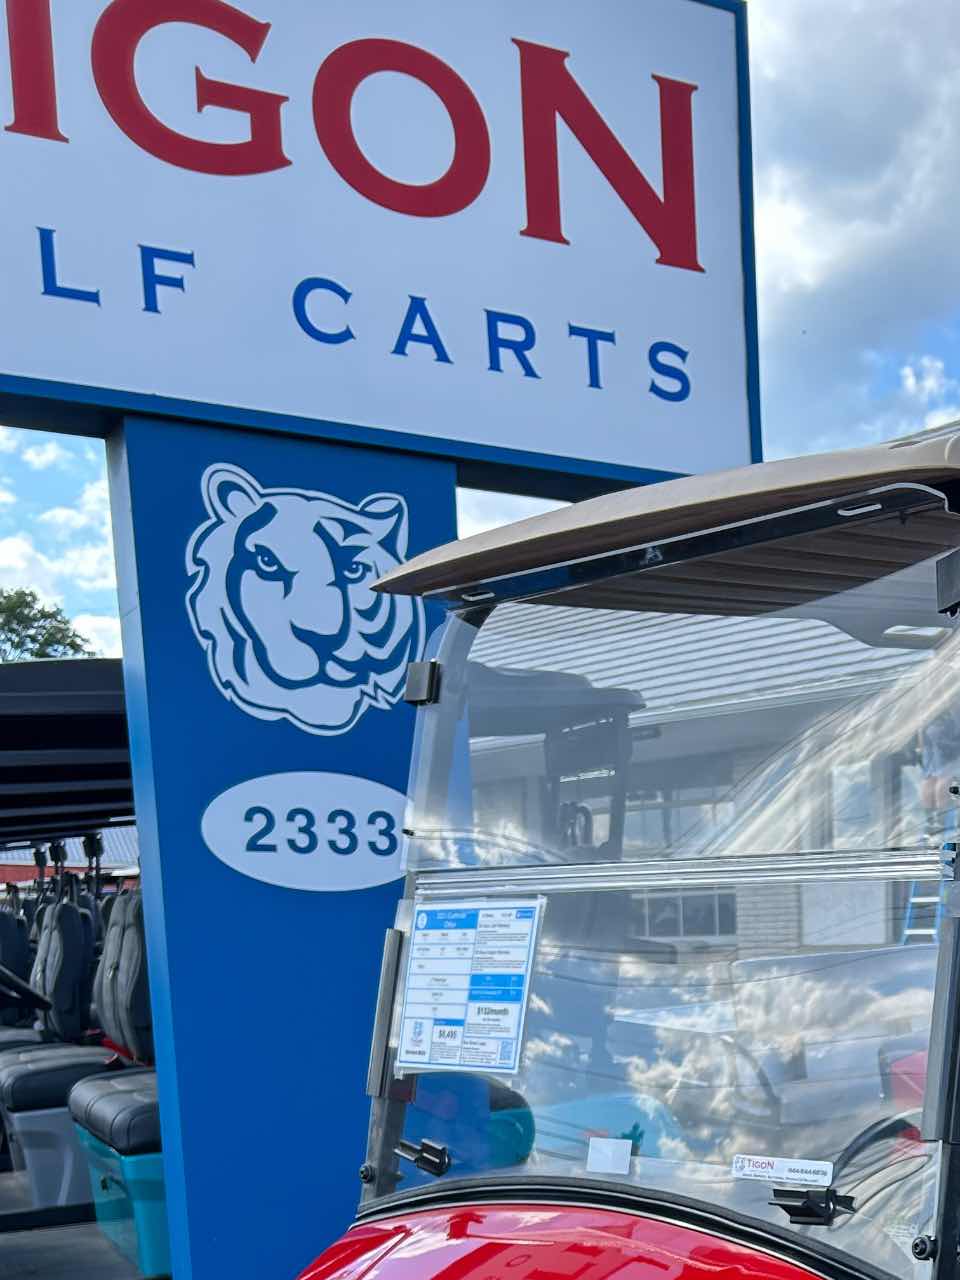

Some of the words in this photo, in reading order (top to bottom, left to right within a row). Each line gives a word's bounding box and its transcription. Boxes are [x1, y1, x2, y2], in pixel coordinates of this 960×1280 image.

[36, 226, 196, 314] LF
[292, 276, 692, 402] CARTS
[243, 805, 398, 857] 2333
[747, 1158, 775, 1170] TIGON
